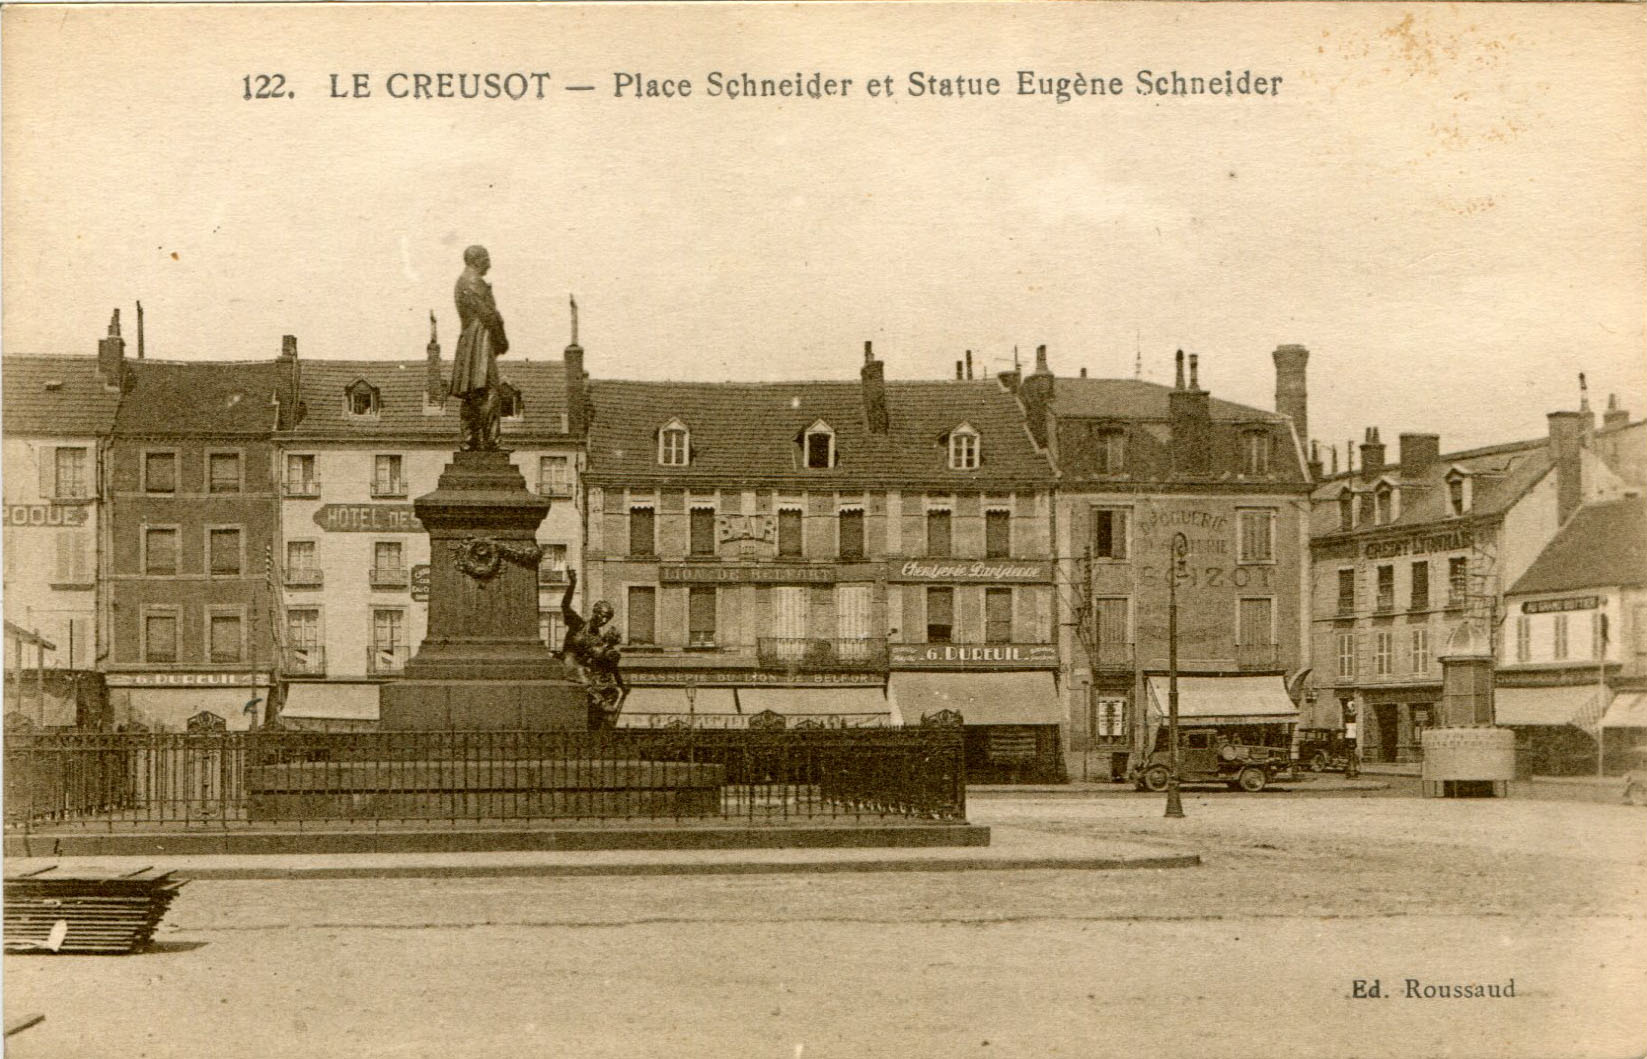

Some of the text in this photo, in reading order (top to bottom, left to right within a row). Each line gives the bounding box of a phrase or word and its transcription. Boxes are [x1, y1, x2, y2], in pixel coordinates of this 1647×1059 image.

[327, 506, 421, 528] HÔTEL DES
[718, 515, 777, 541] BAR
[664, 569, 704, 580] LION
[945, 646, 1022, 661] DUREUIL
[155, 673, 240, 684] DUREUIL
[717, 673, 733, 683] DU
[751, 673, 777, 683] LION
[814, 673, 880, 683] BELFORT
